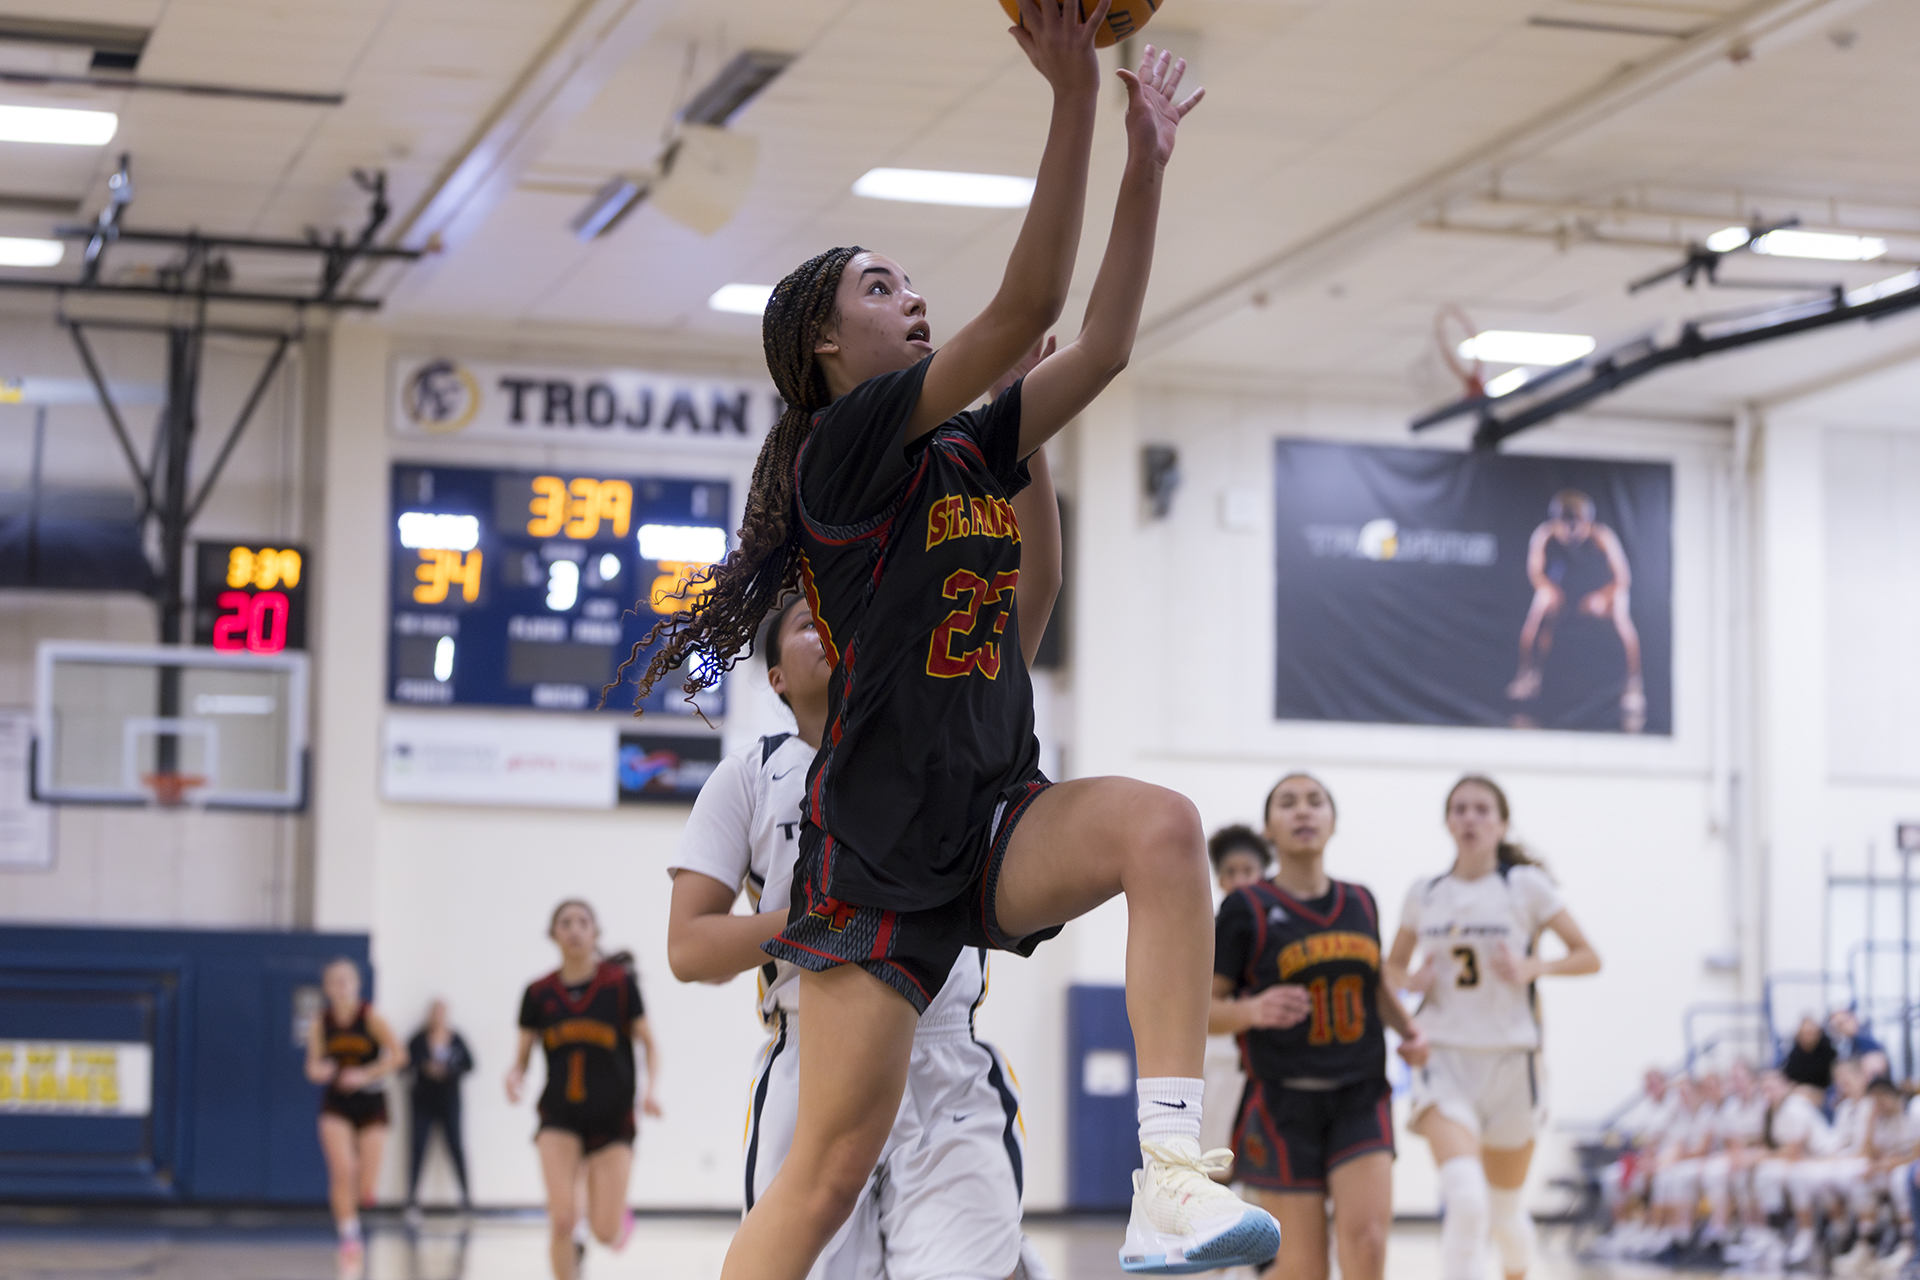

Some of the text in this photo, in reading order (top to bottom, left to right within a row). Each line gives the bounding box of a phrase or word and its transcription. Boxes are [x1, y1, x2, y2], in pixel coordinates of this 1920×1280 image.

[498, 376, 749, 436] TROJAN
[412, 548, 483, 603] 34
[213, 591, 290, 656] 20
[926, 568, 1020, 681] 23
[1452, 944, 1480, 988] 3
[1308, 974, 1366, 1046] 10
